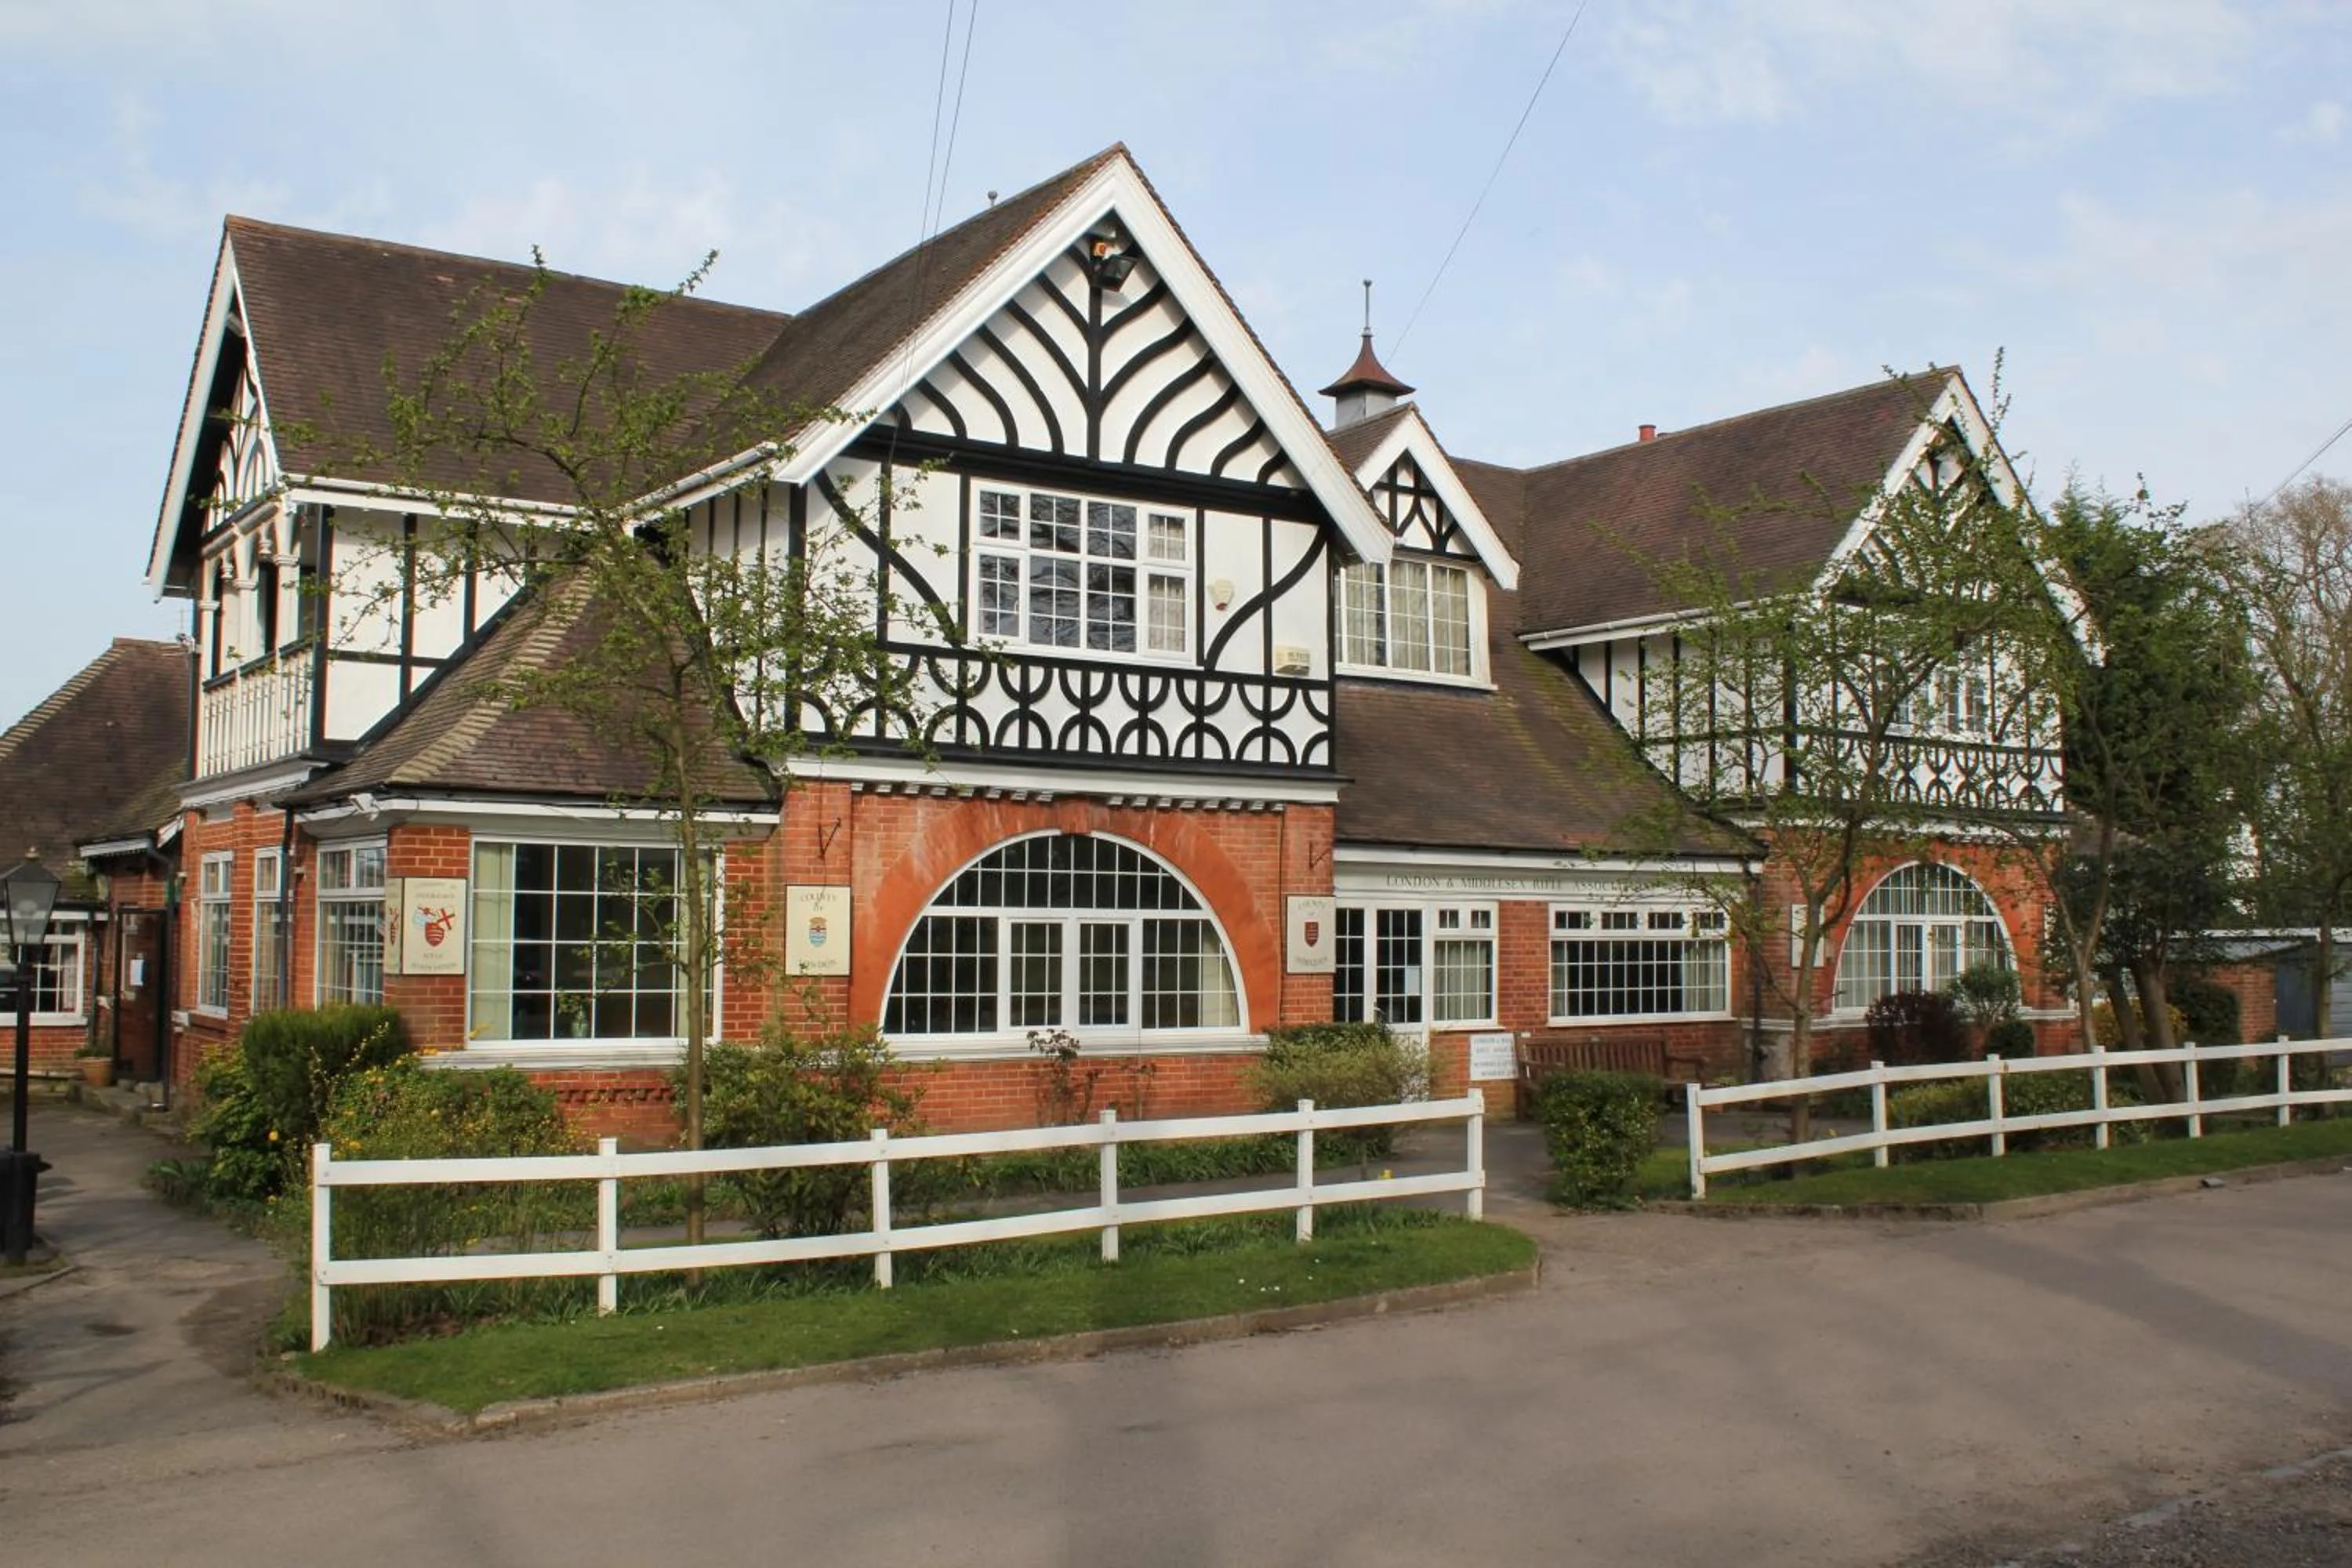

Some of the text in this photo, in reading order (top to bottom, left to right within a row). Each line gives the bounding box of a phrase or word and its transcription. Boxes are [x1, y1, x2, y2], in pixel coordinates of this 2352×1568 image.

[1385, 874, 1441, 889] LONDON
[1446, 877, 1454, 888] &
[1461, 877, 1526, 891] MIDDLESEX
